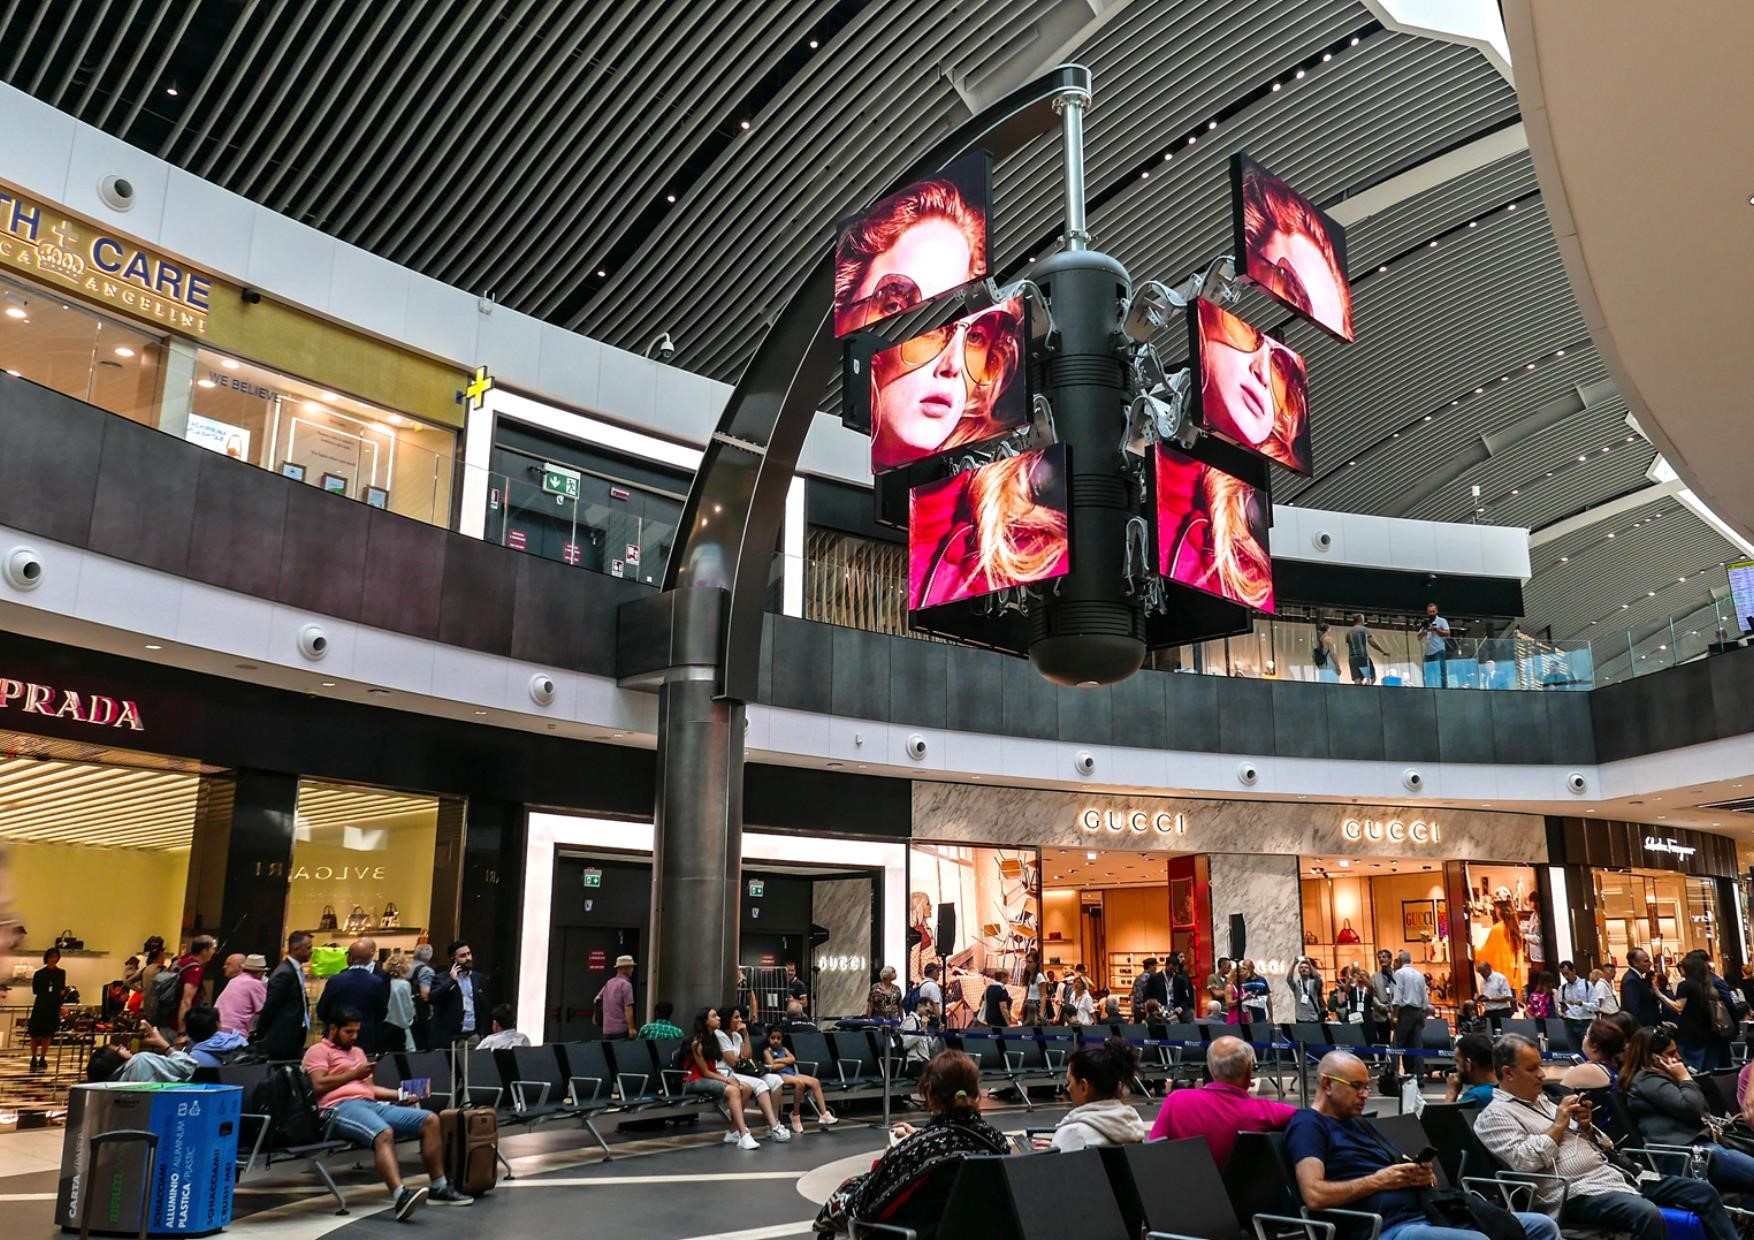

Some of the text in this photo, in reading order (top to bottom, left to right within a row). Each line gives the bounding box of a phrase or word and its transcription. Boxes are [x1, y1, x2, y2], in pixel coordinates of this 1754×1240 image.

[90, 236, 211, 310] CARE
[85, 277, 207, 334] ANGELINI
[0, 677, 145, 731] PRADA
[1080, 808, 1187, 834] GUCCI
[1343, 818, 1441, 843] GUCCI
[819, 956, 866, 972] GUCCI
[69, 1174, 81, 1219] CARTA
[166, 1173, 180, 1228] ALLUMINIO
[178, 1182, 192, 1229] PLASTICA
